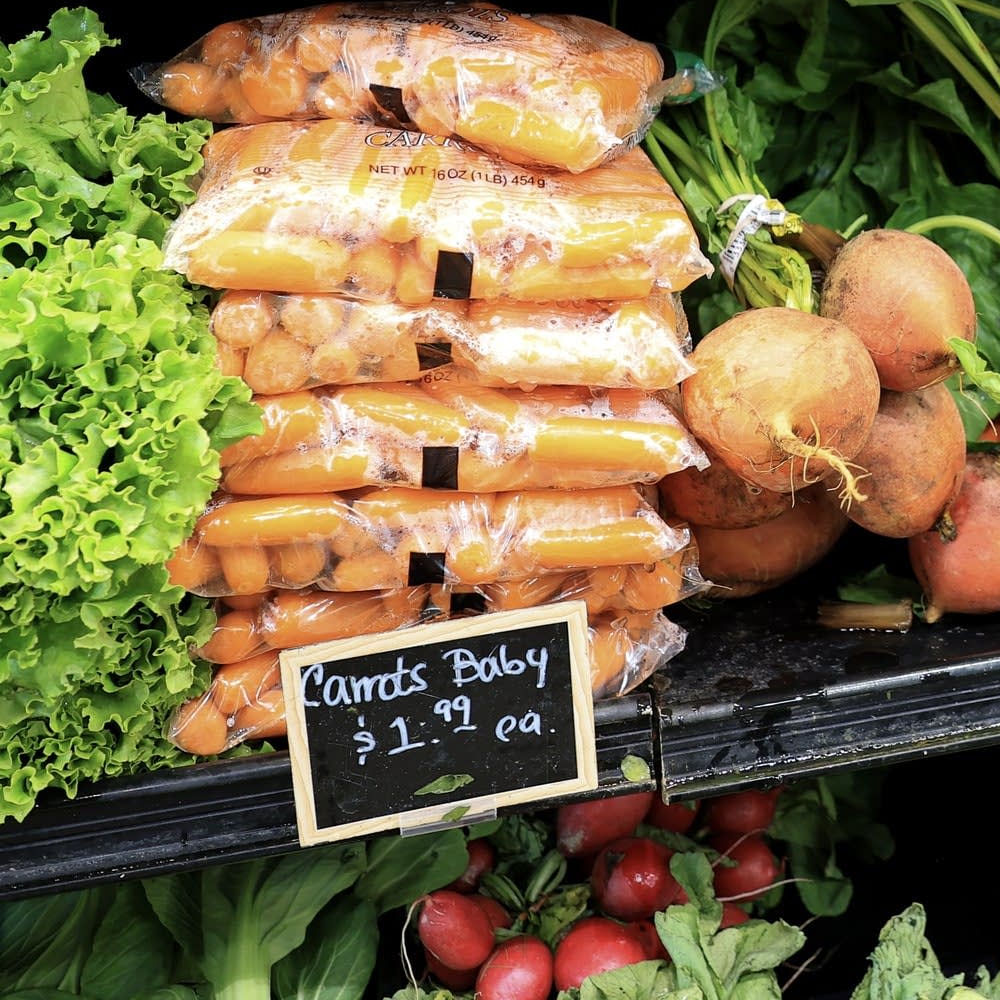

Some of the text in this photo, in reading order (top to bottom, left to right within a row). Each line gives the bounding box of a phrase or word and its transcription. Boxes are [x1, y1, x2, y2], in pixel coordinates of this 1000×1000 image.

[368, 164, 399, 176] NET
[403, 165, 427, 177] WT
[301, 645, 549, 708] Carrots Baby
